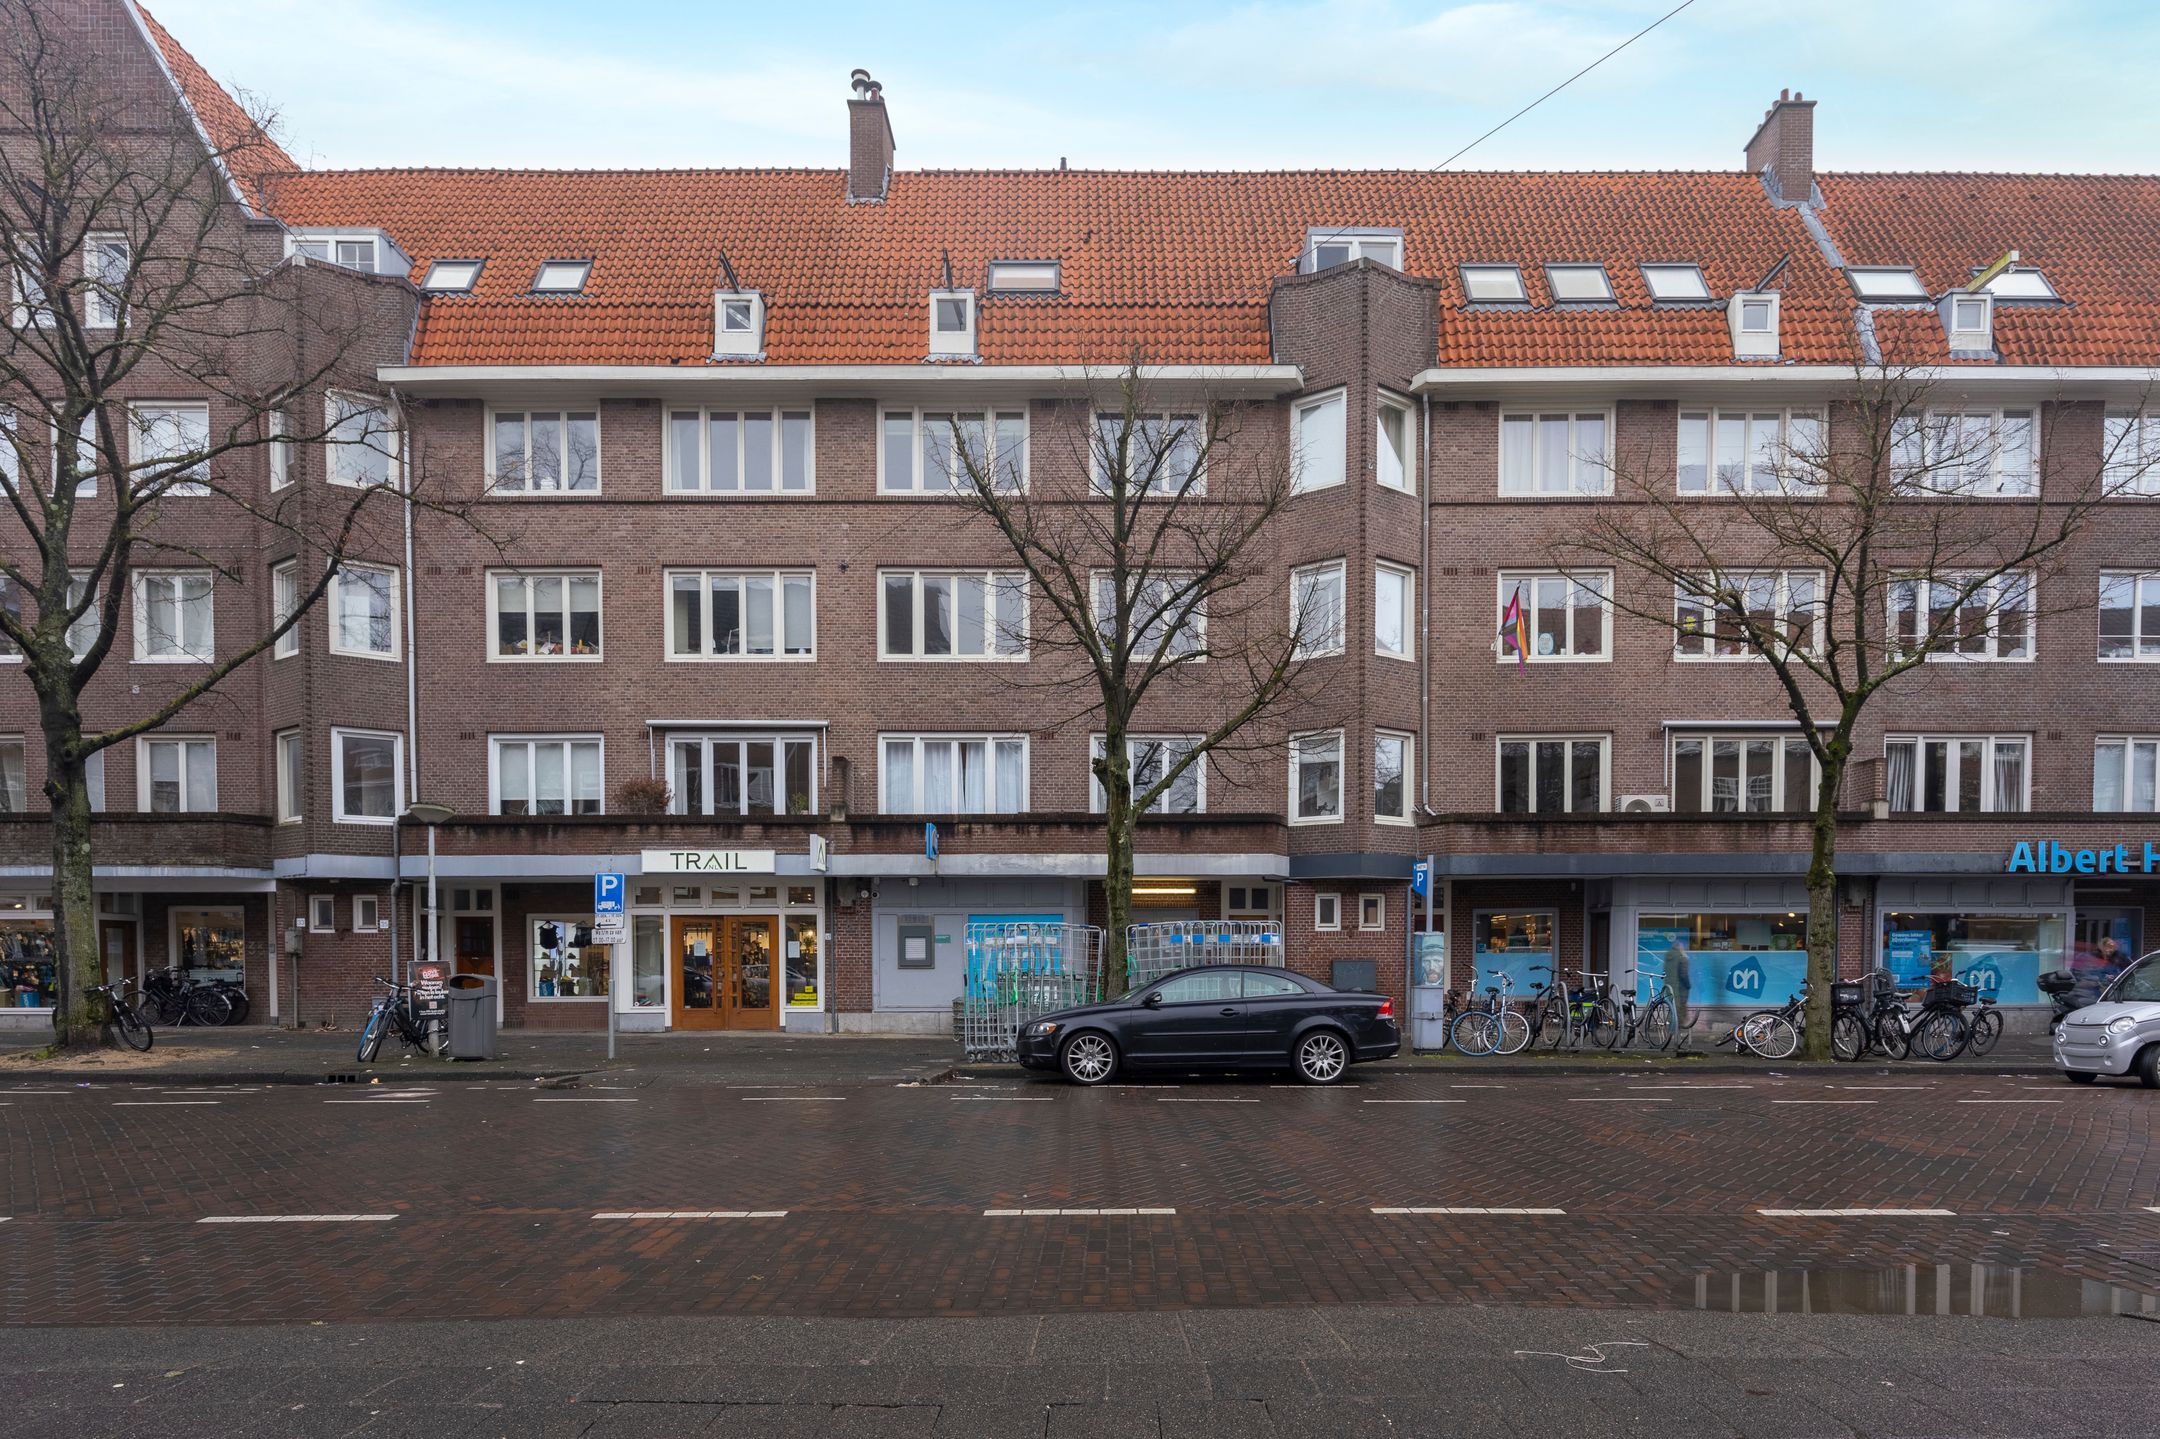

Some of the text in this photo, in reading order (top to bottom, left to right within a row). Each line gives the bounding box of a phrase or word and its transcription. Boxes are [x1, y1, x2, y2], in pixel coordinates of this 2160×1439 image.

[670, 852, 748, 870] TRAIL
[2008, 840, 2129, 873] Albert
[602, 876, 618, 897] P
[1417, 872, 1424, 887] P
